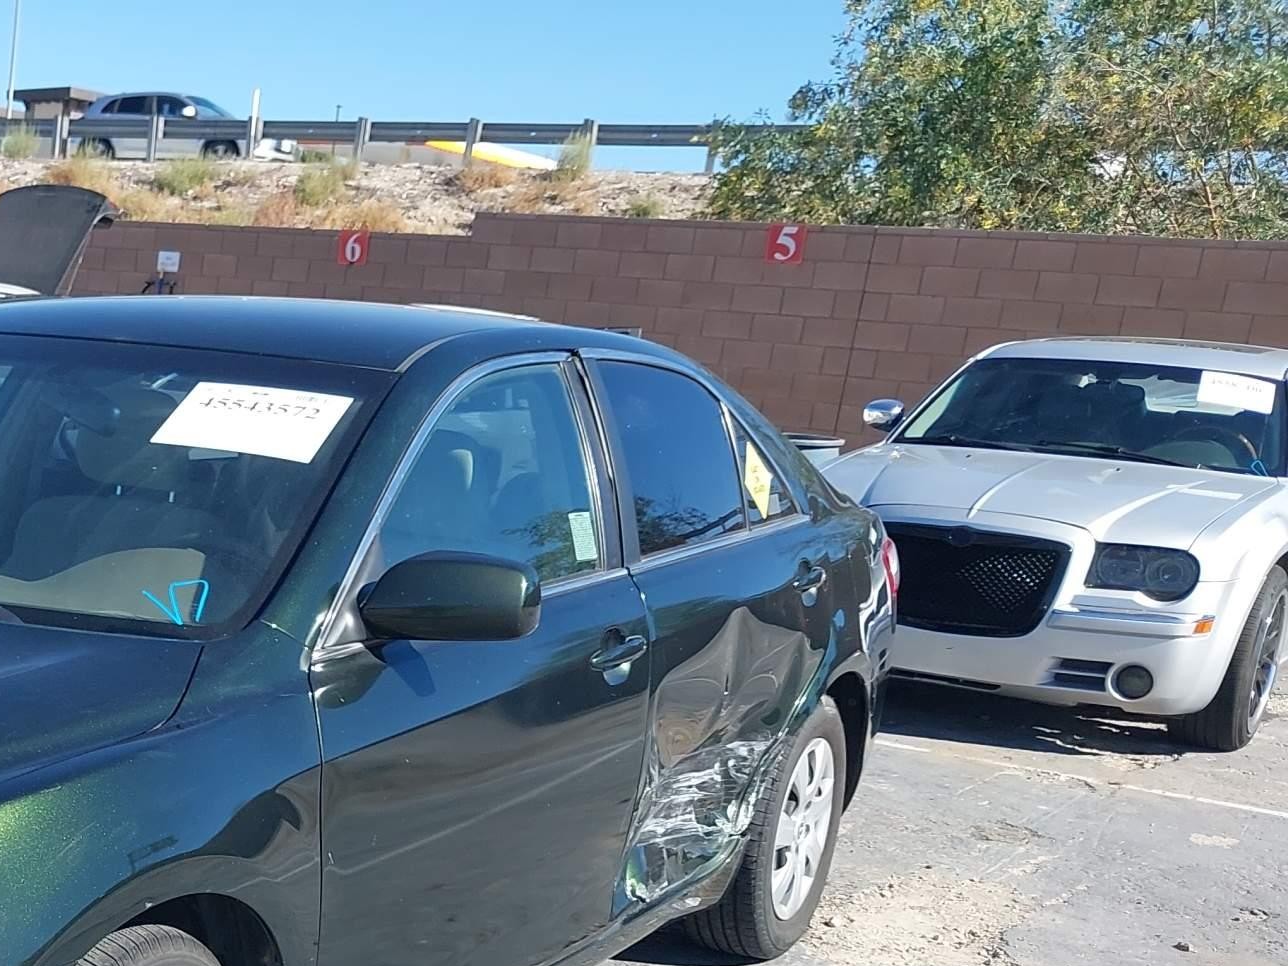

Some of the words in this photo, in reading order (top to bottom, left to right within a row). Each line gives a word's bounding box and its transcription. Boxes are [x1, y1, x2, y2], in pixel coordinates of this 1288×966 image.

[345, 232, 361, 262] 6
[774, 226, 799, 260] 5
[199, 396, 321, 420] 45543572
